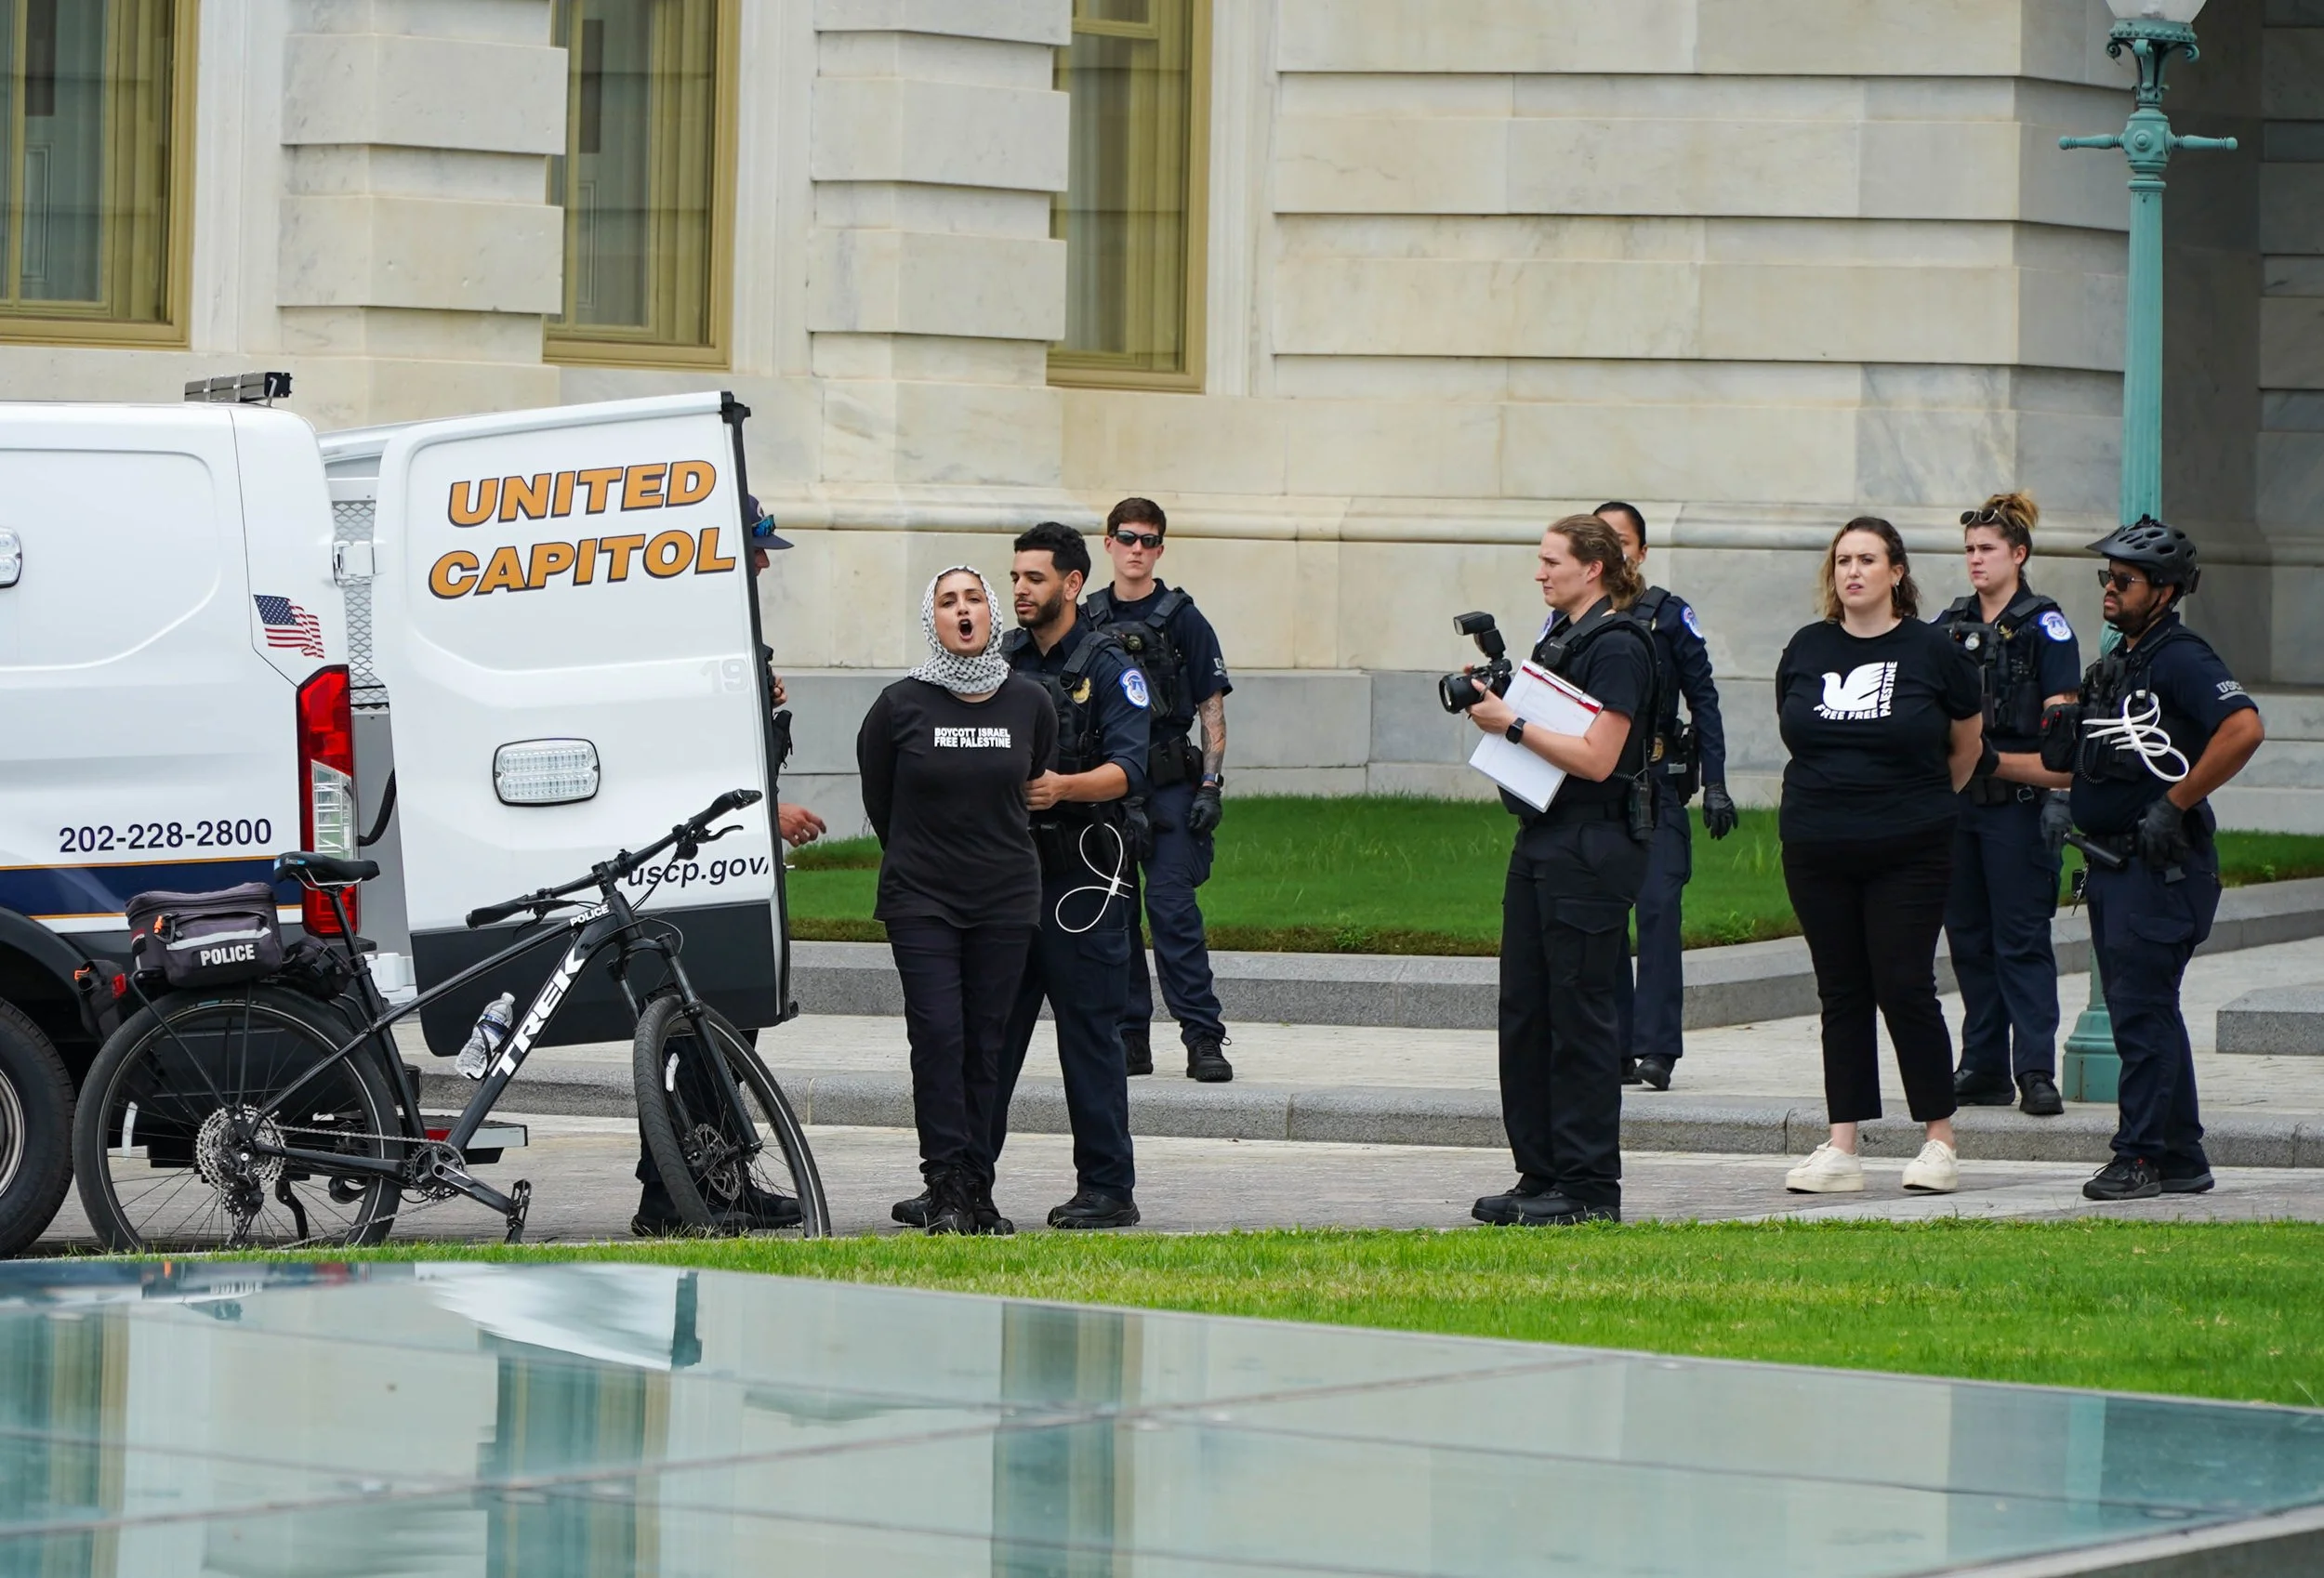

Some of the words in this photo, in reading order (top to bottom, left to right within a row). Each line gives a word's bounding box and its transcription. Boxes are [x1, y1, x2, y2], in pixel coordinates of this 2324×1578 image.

[447, 459, 717, 528] UNITED
[429, 527, 736, 599] CAPITOL
[699, 658, 749, 694] 19
[1813, 704, 1845, 720] FREE
[1847, 708, 1879, 720] FREE
[1879, 661, 1898, 717] PALESTINE
[934, 727, 976, 737] BOYCOTT
[978, 728, 1010, 738] ISRAEL
[934, 736, 958, 747] FREE
[959, 736, 1011, 748] PALESTINE
[59, 818, 272, 853] 202-228-2800
[569, 903, 610, 927] POLICE
[200, 943, 256, 967] POLICE
[491, 947, 586, 1078] TREK
